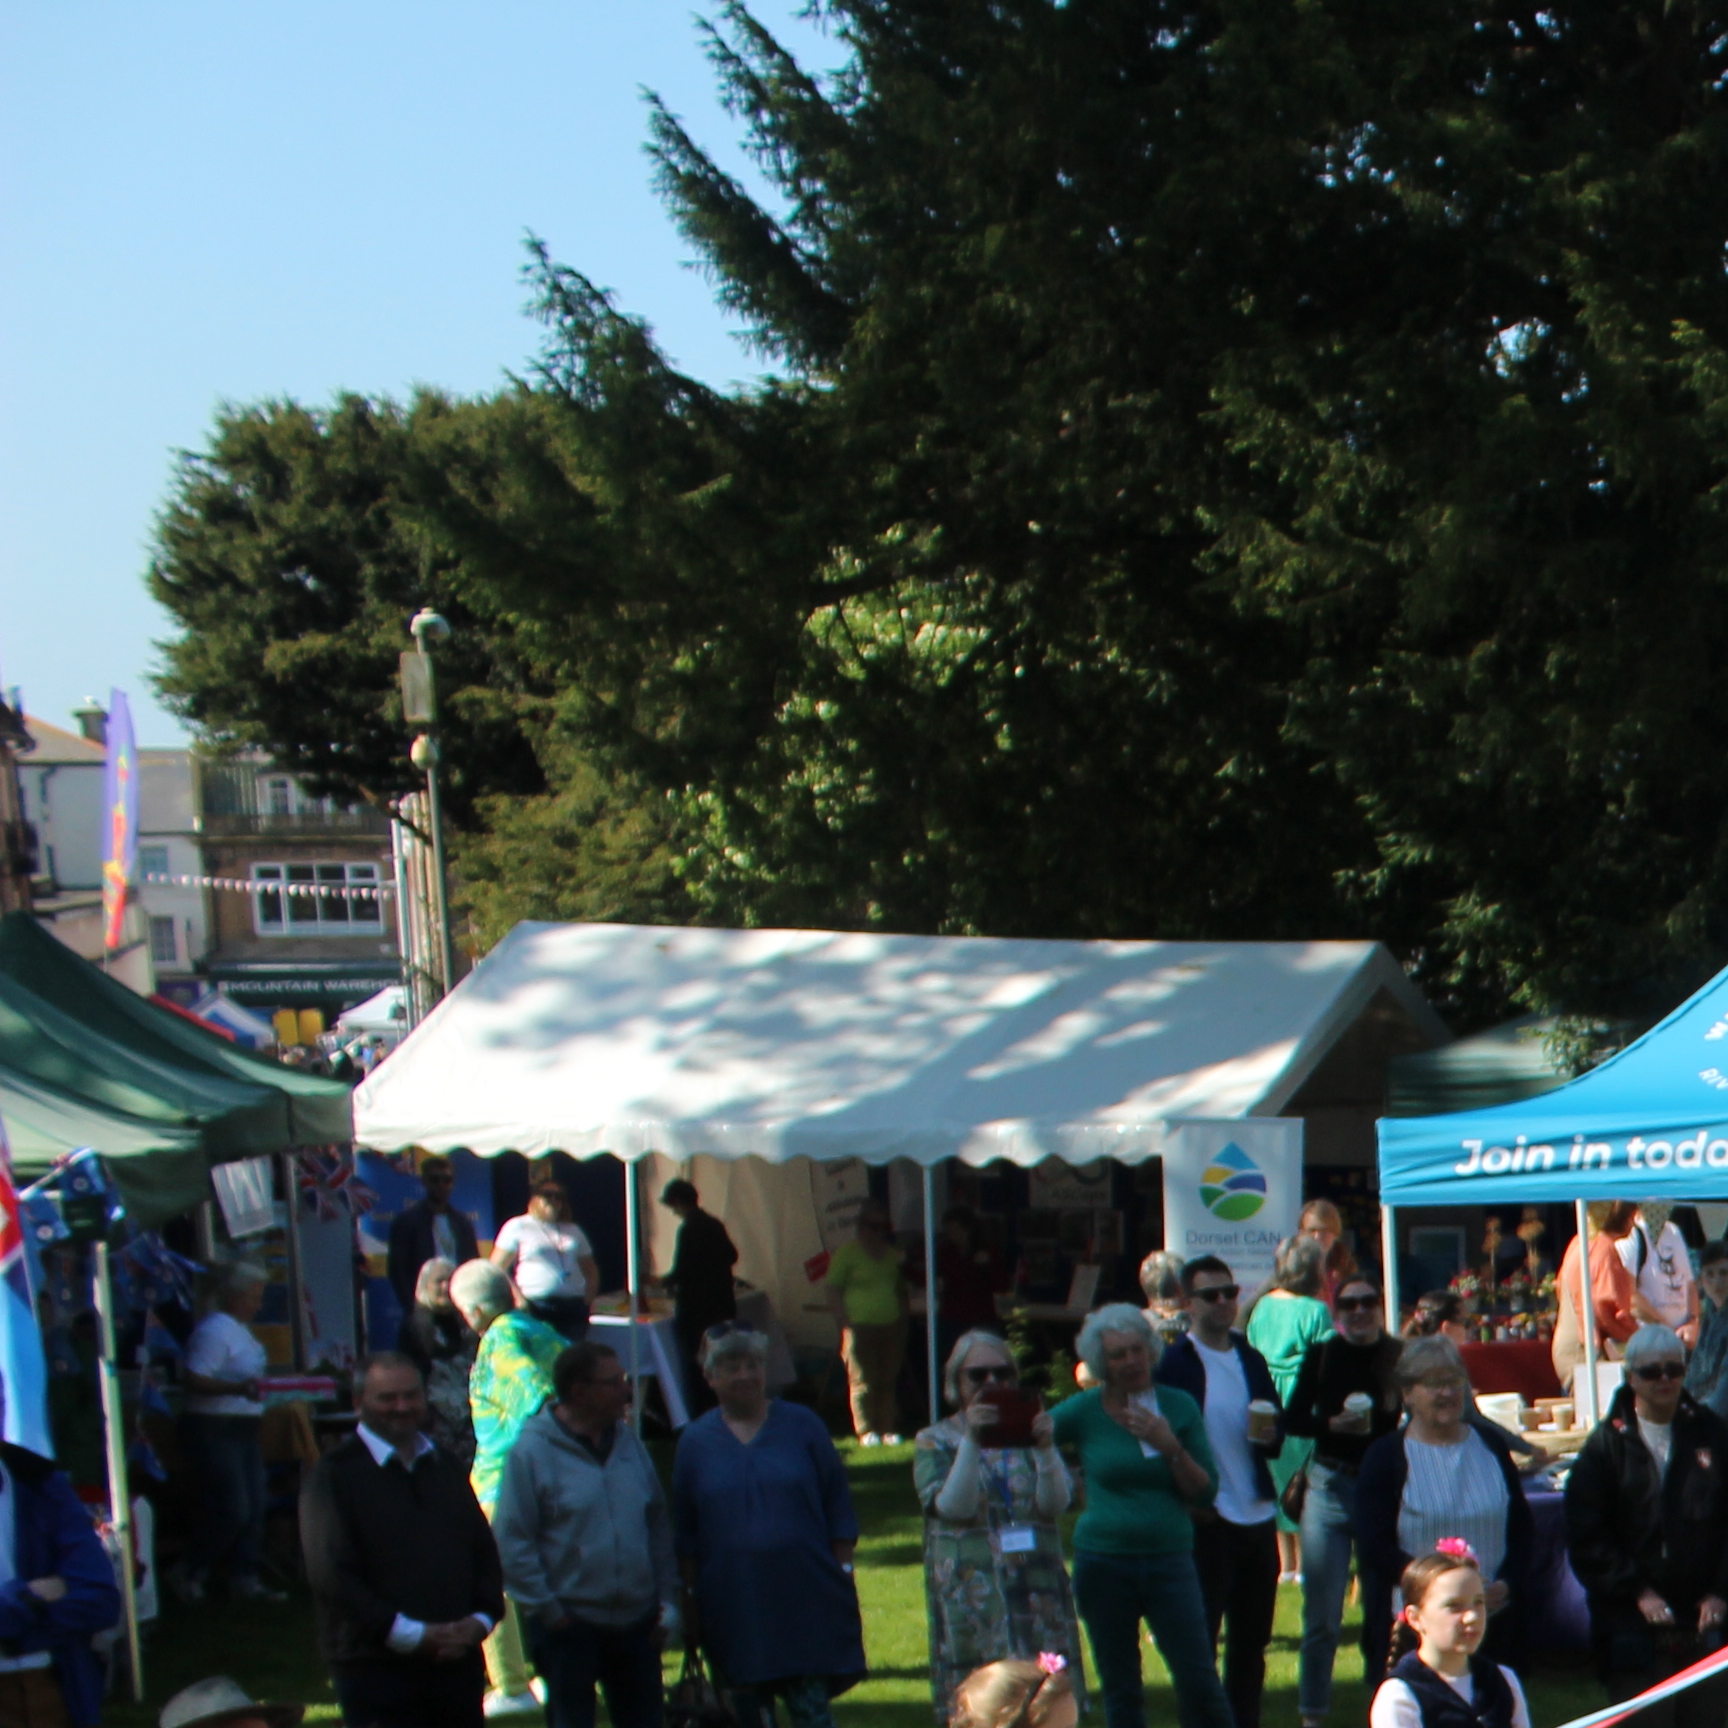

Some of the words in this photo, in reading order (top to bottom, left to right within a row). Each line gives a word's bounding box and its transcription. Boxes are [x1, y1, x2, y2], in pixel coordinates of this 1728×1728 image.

[231, 980, 319, 992] MOUNTAIN
[1454, 1133, 1555, 1176] Join
[1568, 1133, 1612, 1171] in
[1186, 1229, 1239, 1245] Dorset
[1243, 1229, 1281, 1245] CAN
